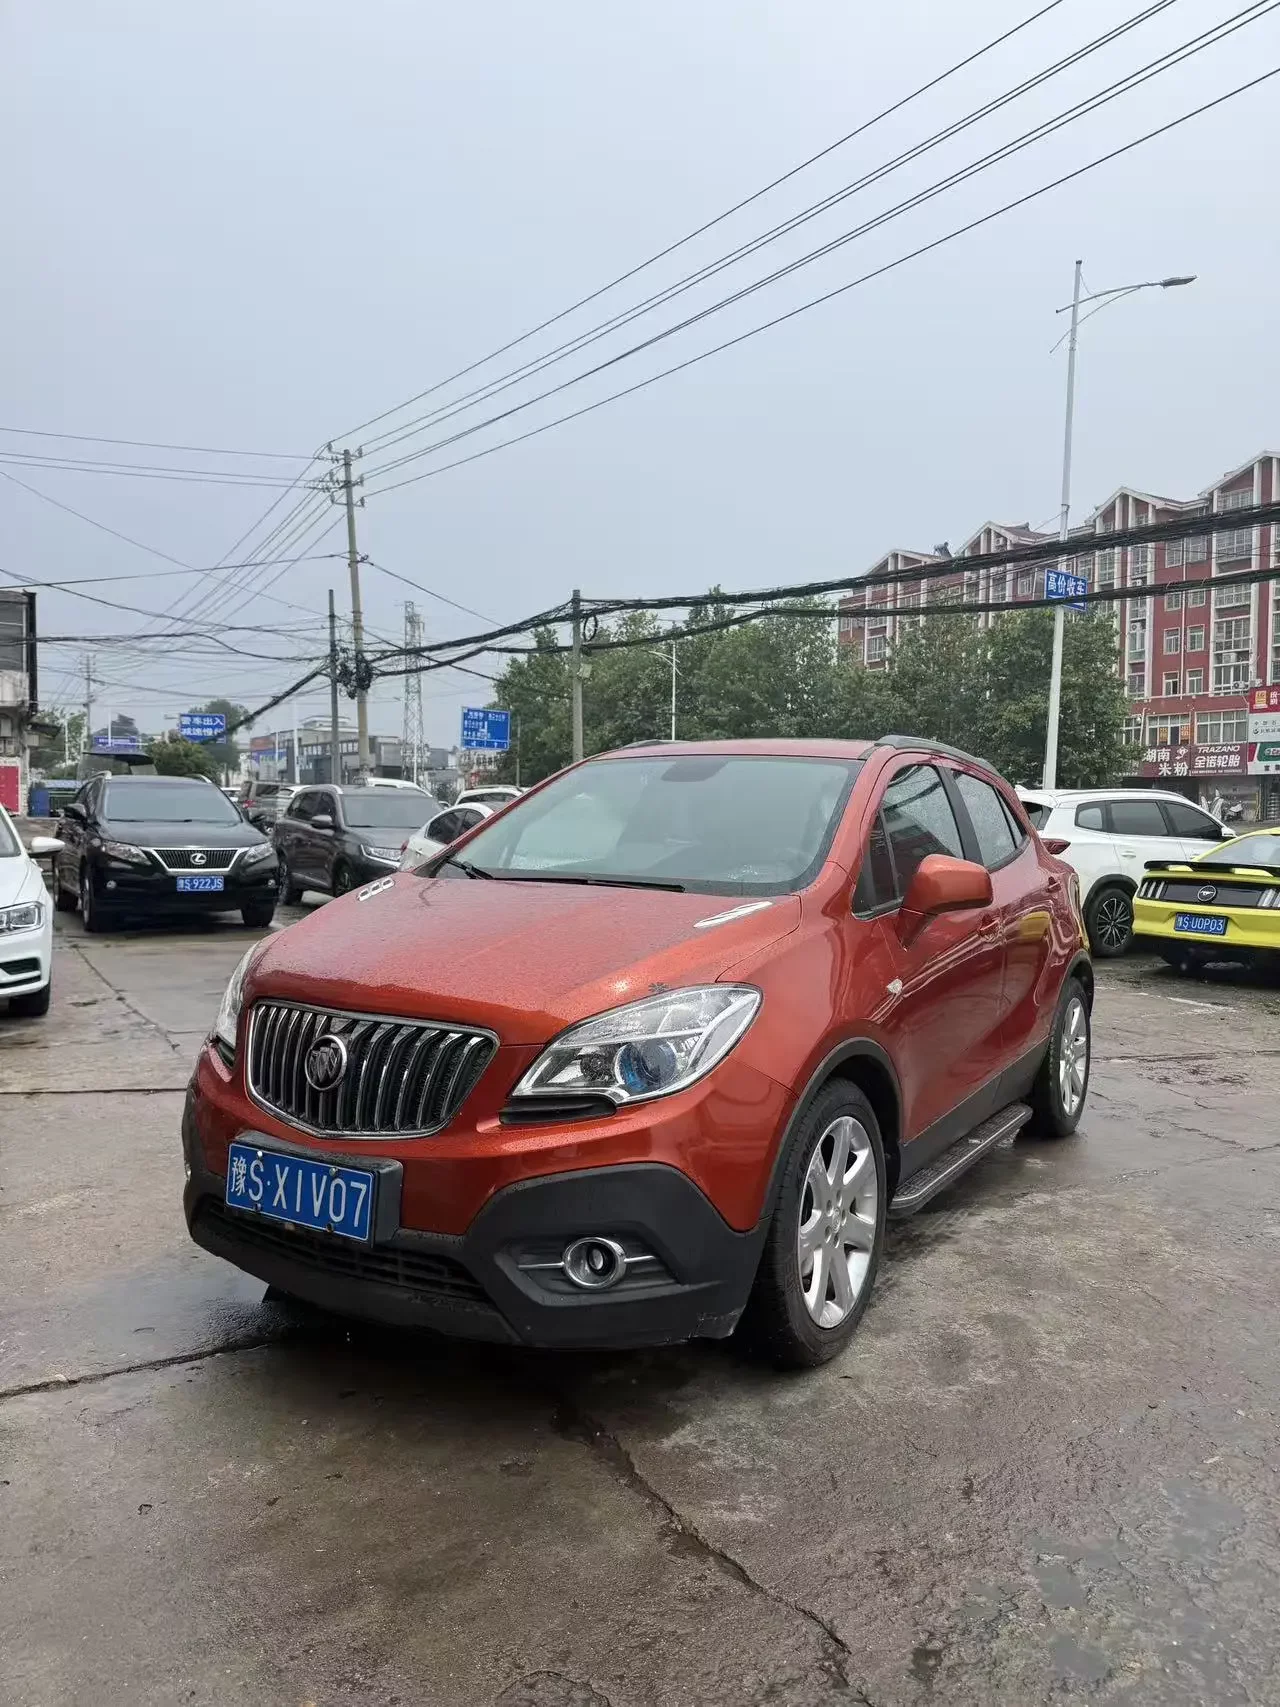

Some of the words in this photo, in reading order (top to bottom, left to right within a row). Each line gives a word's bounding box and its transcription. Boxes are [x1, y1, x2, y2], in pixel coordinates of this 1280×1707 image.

[1047, 572, 1086, 597] 高价收车
[1141, 748, 1171, 763] 湖南
[1197, 745, 1241, 754] TRAZANO
[1158, 761, 1189, 777] 米粉
[1194, 755, 1241, 769] 全诺轮胎
